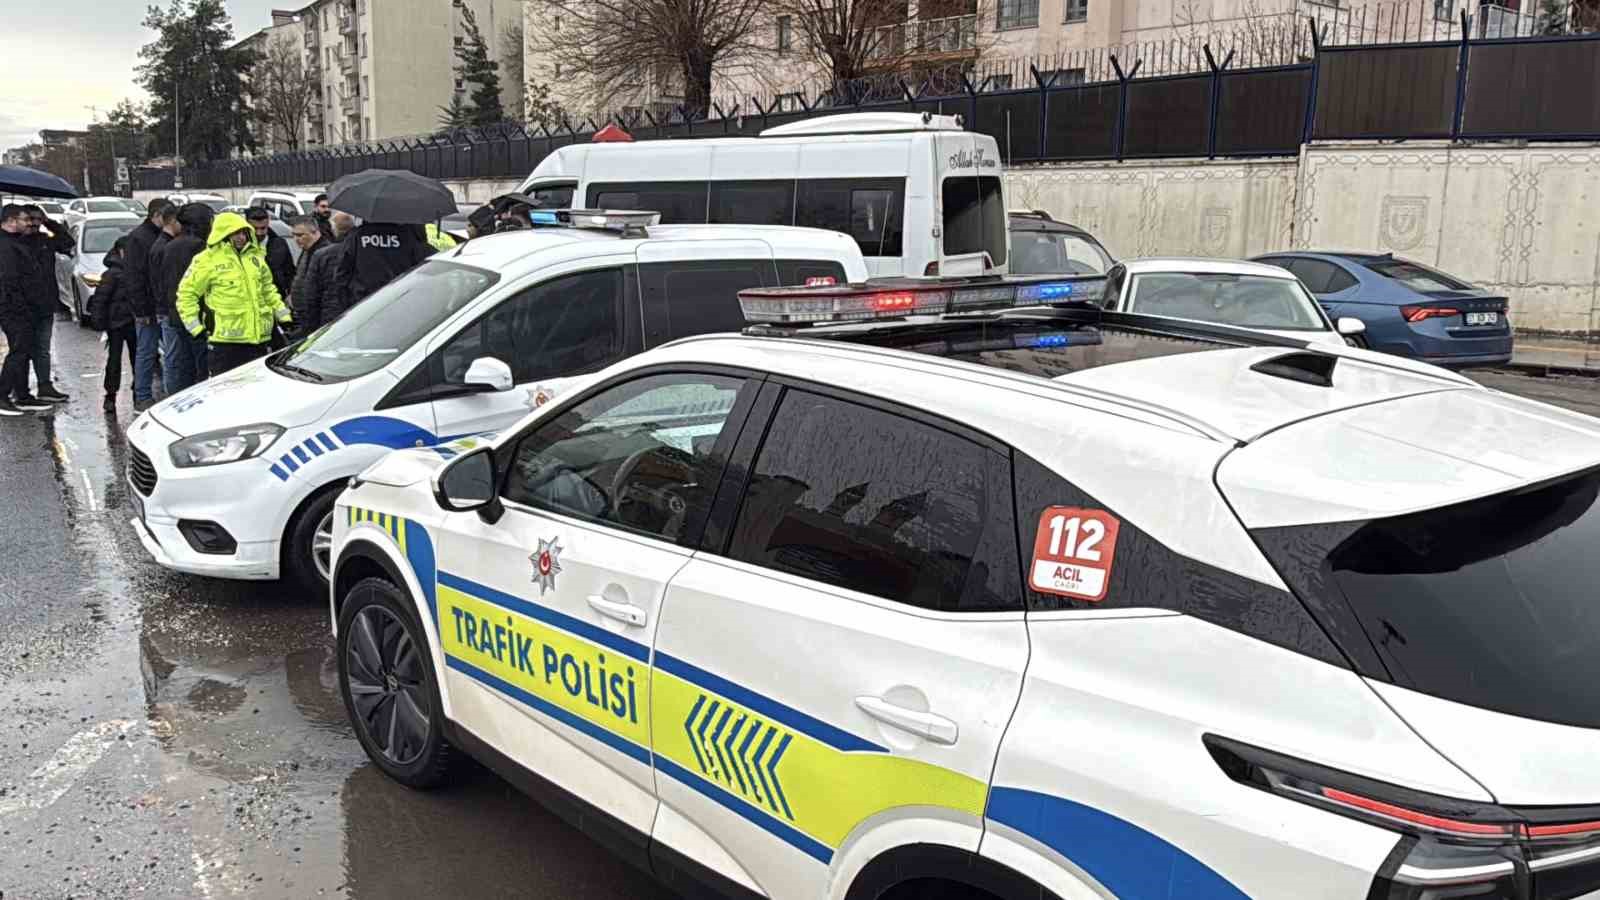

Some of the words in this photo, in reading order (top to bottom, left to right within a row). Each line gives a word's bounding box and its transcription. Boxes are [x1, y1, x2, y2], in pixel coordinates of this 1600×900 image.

[1048, 514, 1105, 562] 112
[451, 606, 535, 677] TRAFİK
[542, 644, 638, 724] POLİSİ
